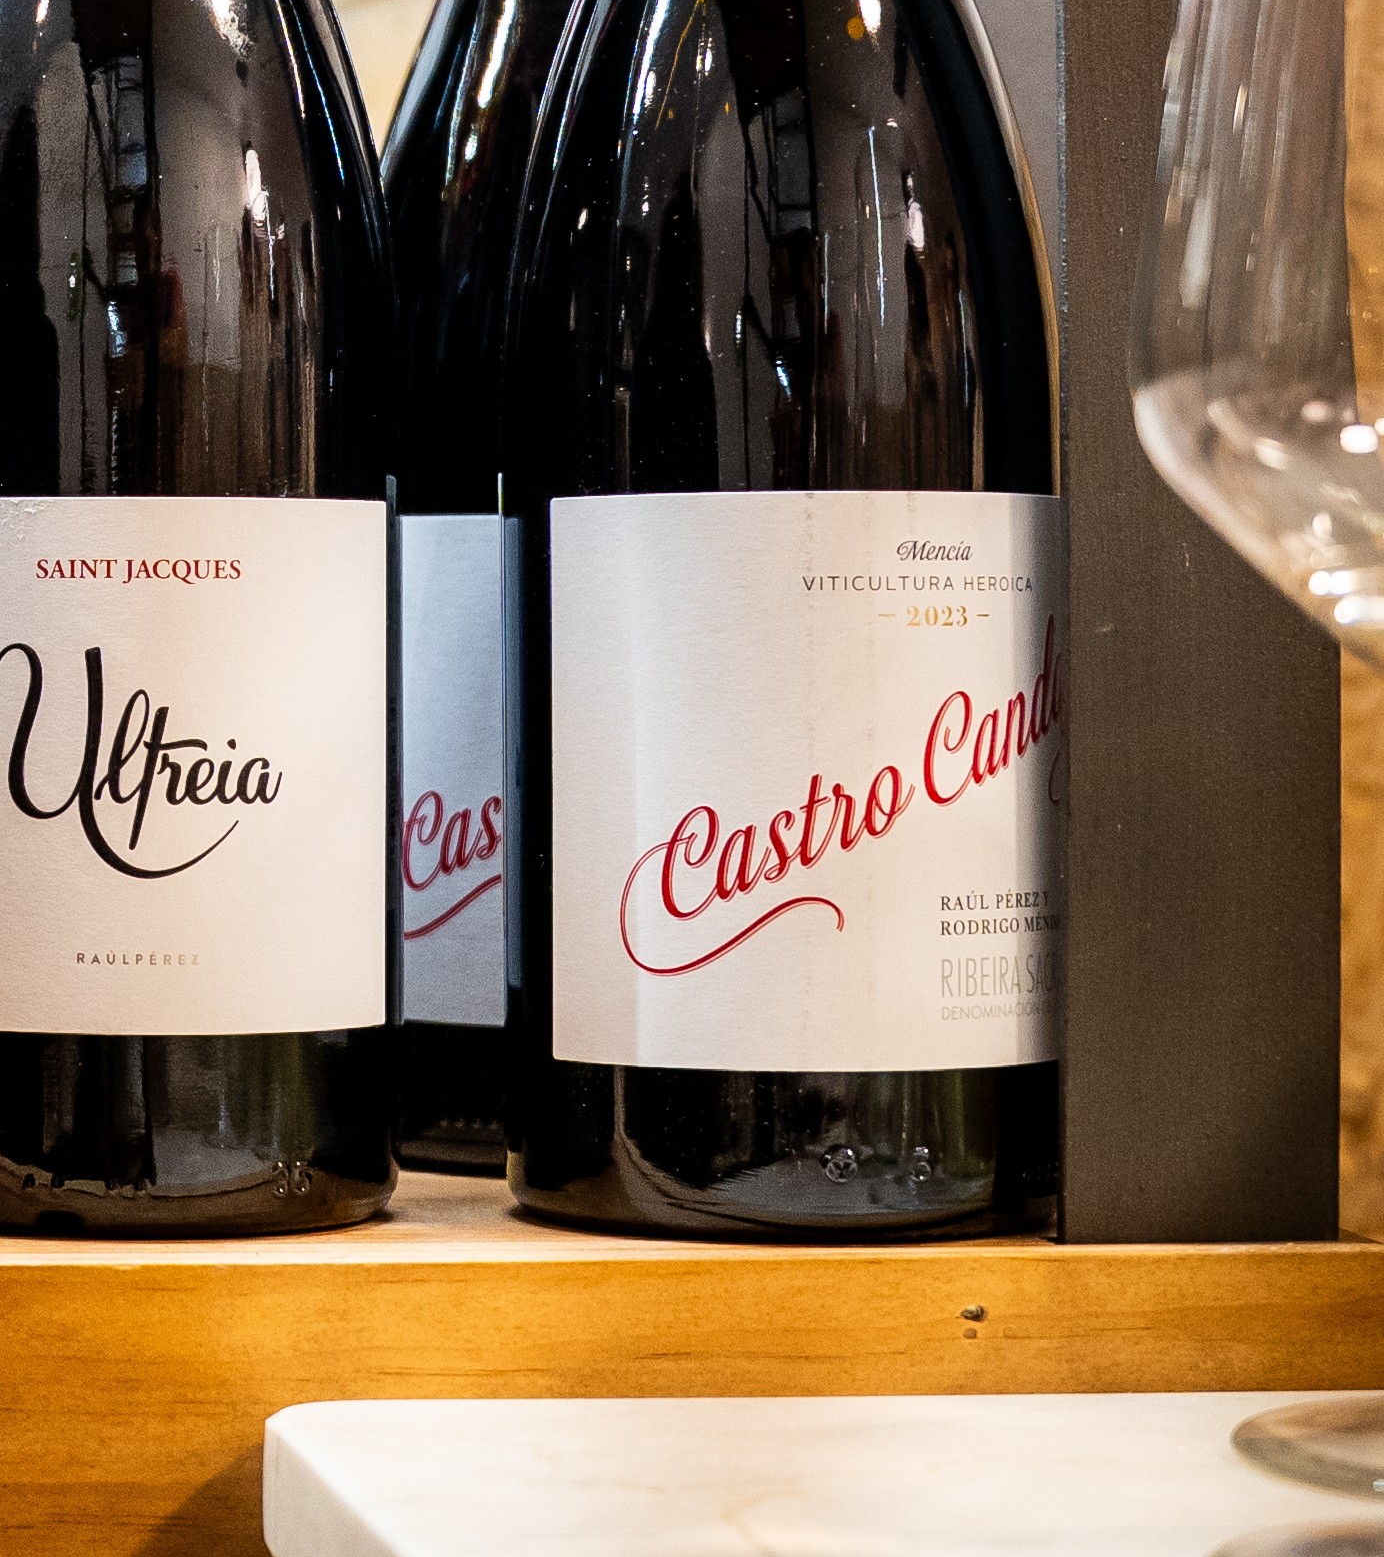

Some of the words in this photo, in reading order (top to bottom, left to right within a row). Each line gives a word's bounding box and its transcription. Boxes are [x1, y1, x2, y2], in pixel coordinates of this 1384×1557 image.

[895, 539, 974, 562] Mencía
[35, 557, 118, 582] SAINT
[121, 557, 243, 585] JACQUES
[801, 574, 956, 592] VITICULTURA
[963, 575, 1034, 593] HEROICA
[905, 604, 970, 627] 2023
[620, 771, 916, 977] Castro
[940, 889, 990, 911] RAÚL
[995, 888, 1041, 910] PÉREZ
[939, 917, 1020, 936] RODRIGO
[940, 955, 1022, 998] RIBEIRA
